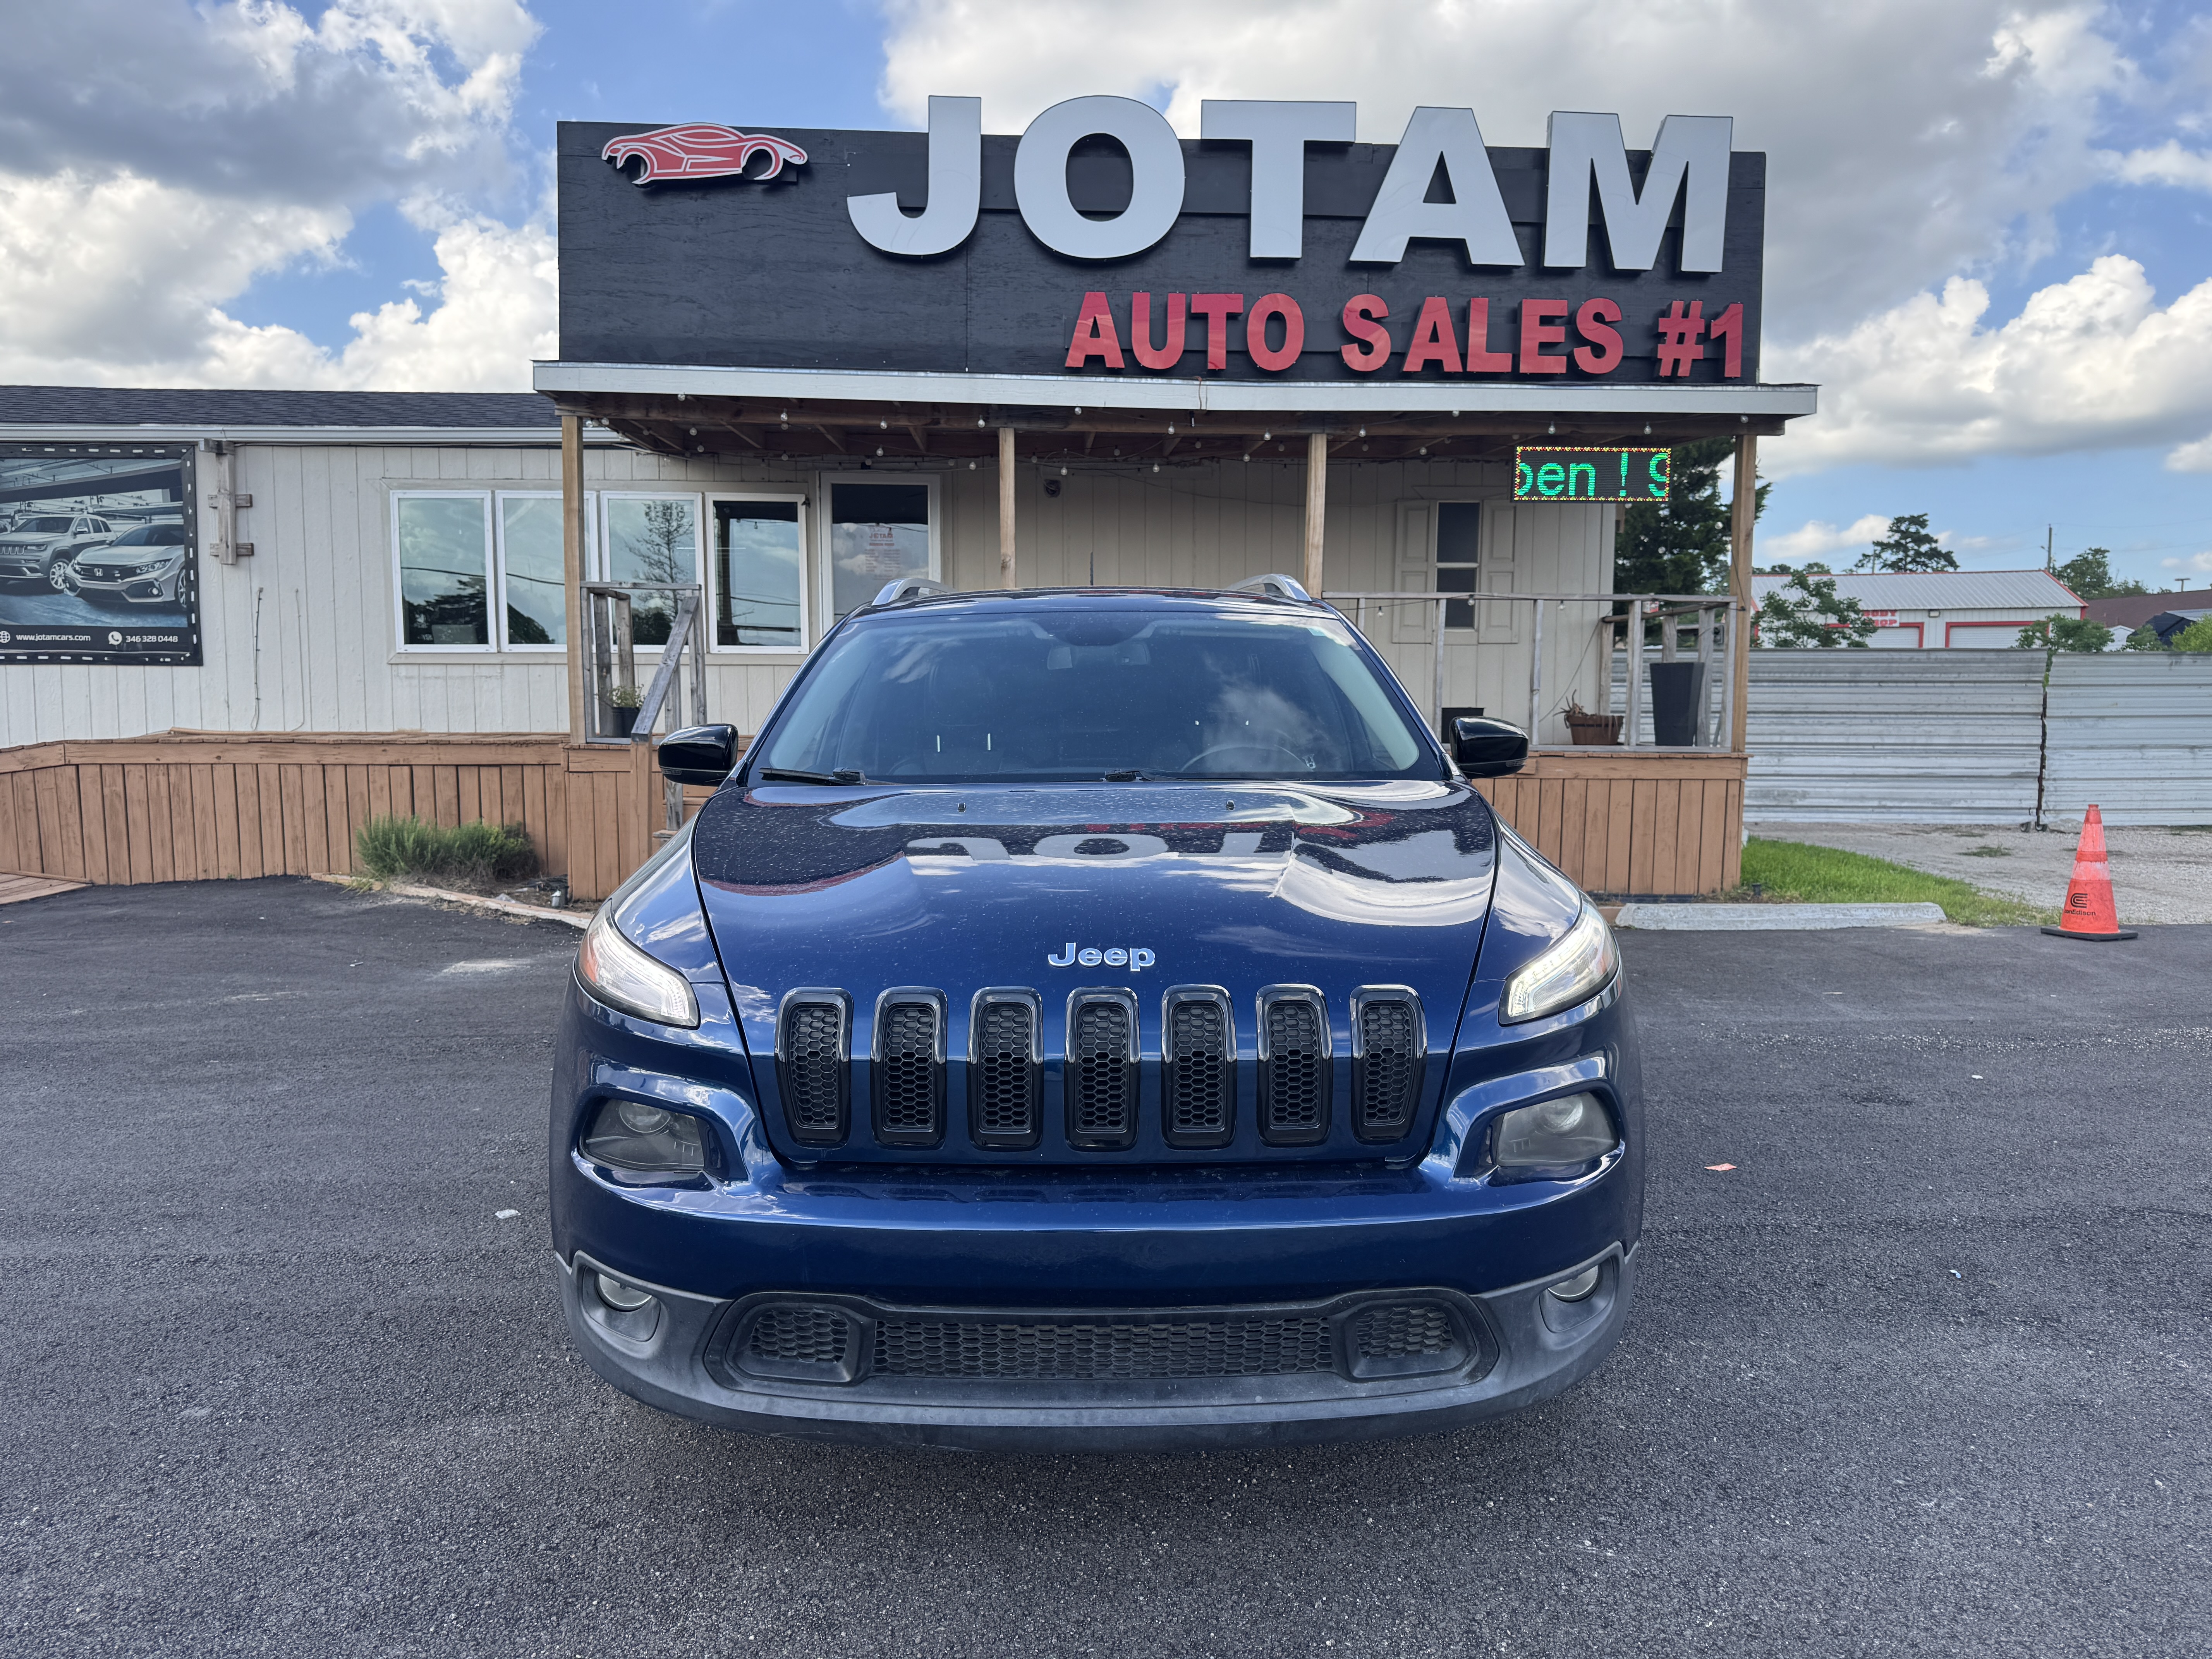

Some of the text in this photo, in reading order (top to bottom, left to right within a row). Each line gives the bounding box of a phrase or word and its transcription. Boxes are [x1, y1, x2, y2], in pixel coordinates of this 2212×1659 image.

[847, 95, 1733, 272] JOTAM
[1065, 291, 1743, 377] AUTO SALES #1
[16, 633, 91, 641] www.jotamcars.com
[1048, 942, 1156, 971] Jeep
